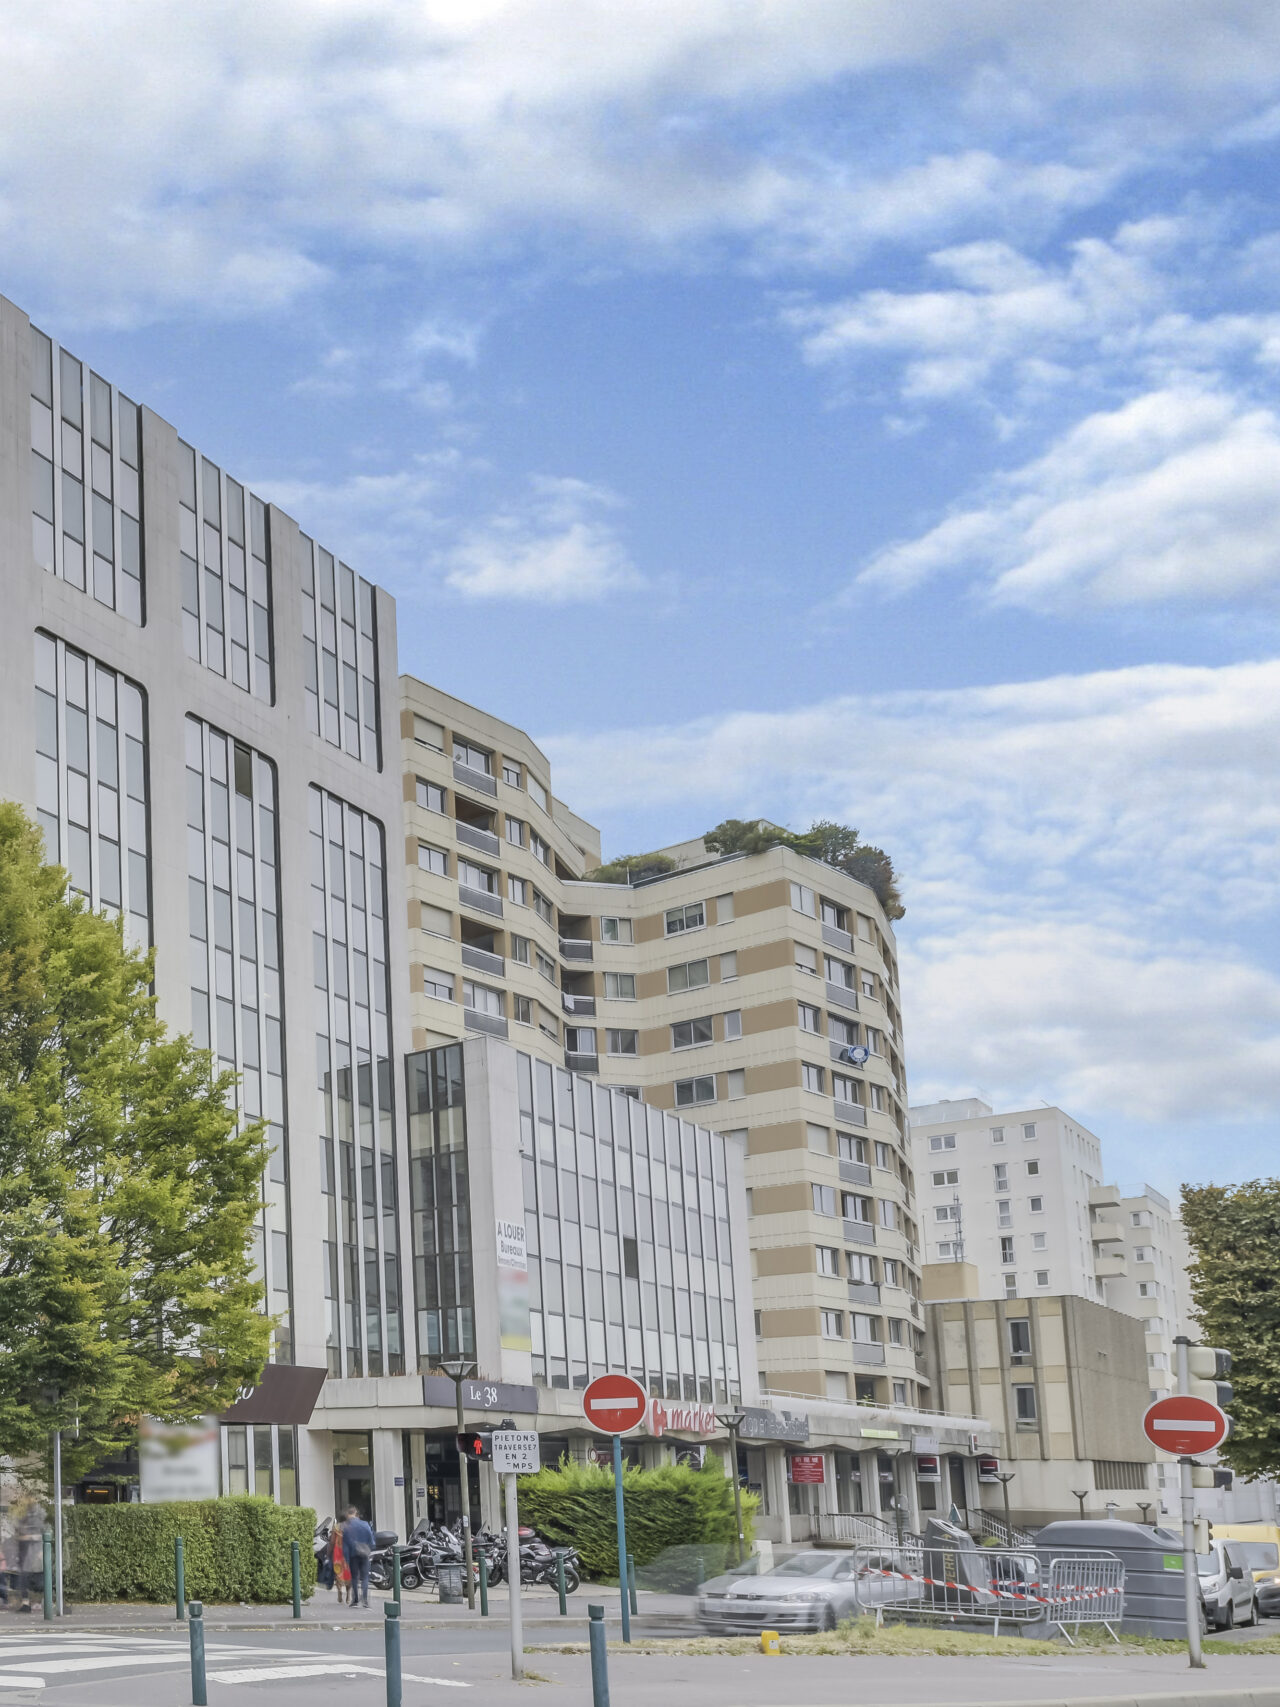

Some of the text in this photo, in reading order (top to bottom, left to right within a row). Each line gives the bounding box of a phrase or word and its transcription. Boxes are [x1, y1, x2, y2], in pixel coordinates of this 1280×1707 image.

[497, 1221, 525, 1242] A LOUER
[470, 1386, 498, 1407] Le 38
[670, 1404, 716, 1434] market
